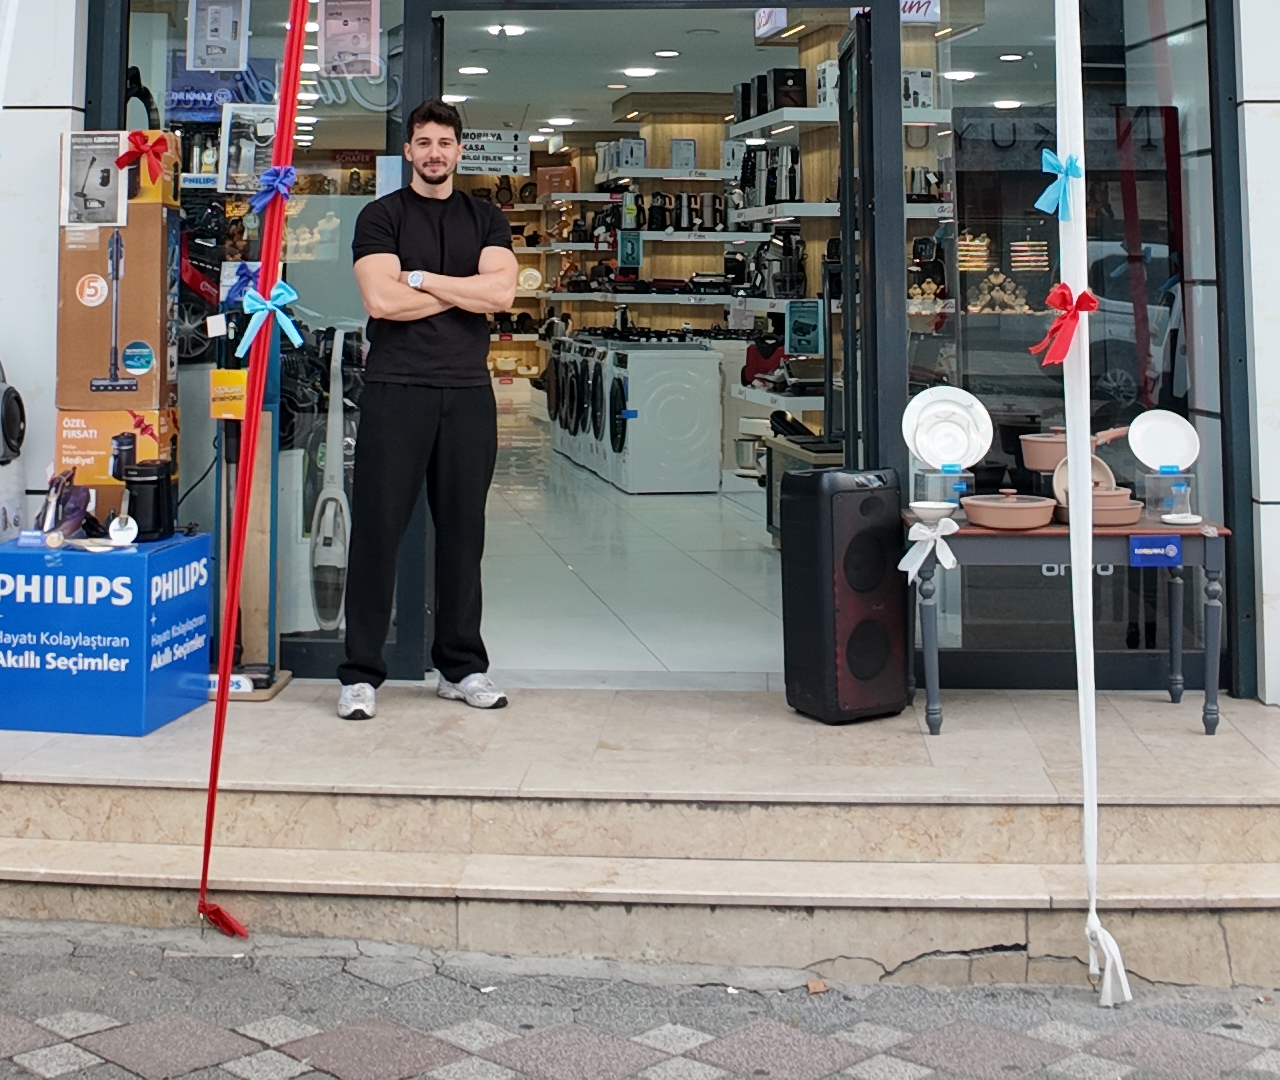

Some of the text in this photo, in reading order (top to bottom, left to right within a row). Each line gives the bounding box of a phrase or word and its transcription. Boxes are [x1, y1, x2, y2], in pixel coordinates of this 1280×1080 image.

[463, 144, 485, 152] KASA
[182, 176, 218, 186] PHILIPS
[62, 417, 87, 428] ÖZEL
[62, 429, 98, 439] FIRSAT!
[150, 557, 208, 607] PHILIPS
[40, 630, 130, 651] Kolaylaştıran
[45, 652, 130, 676] Seçimler
[150, 646, 173, 672] Akıllı
